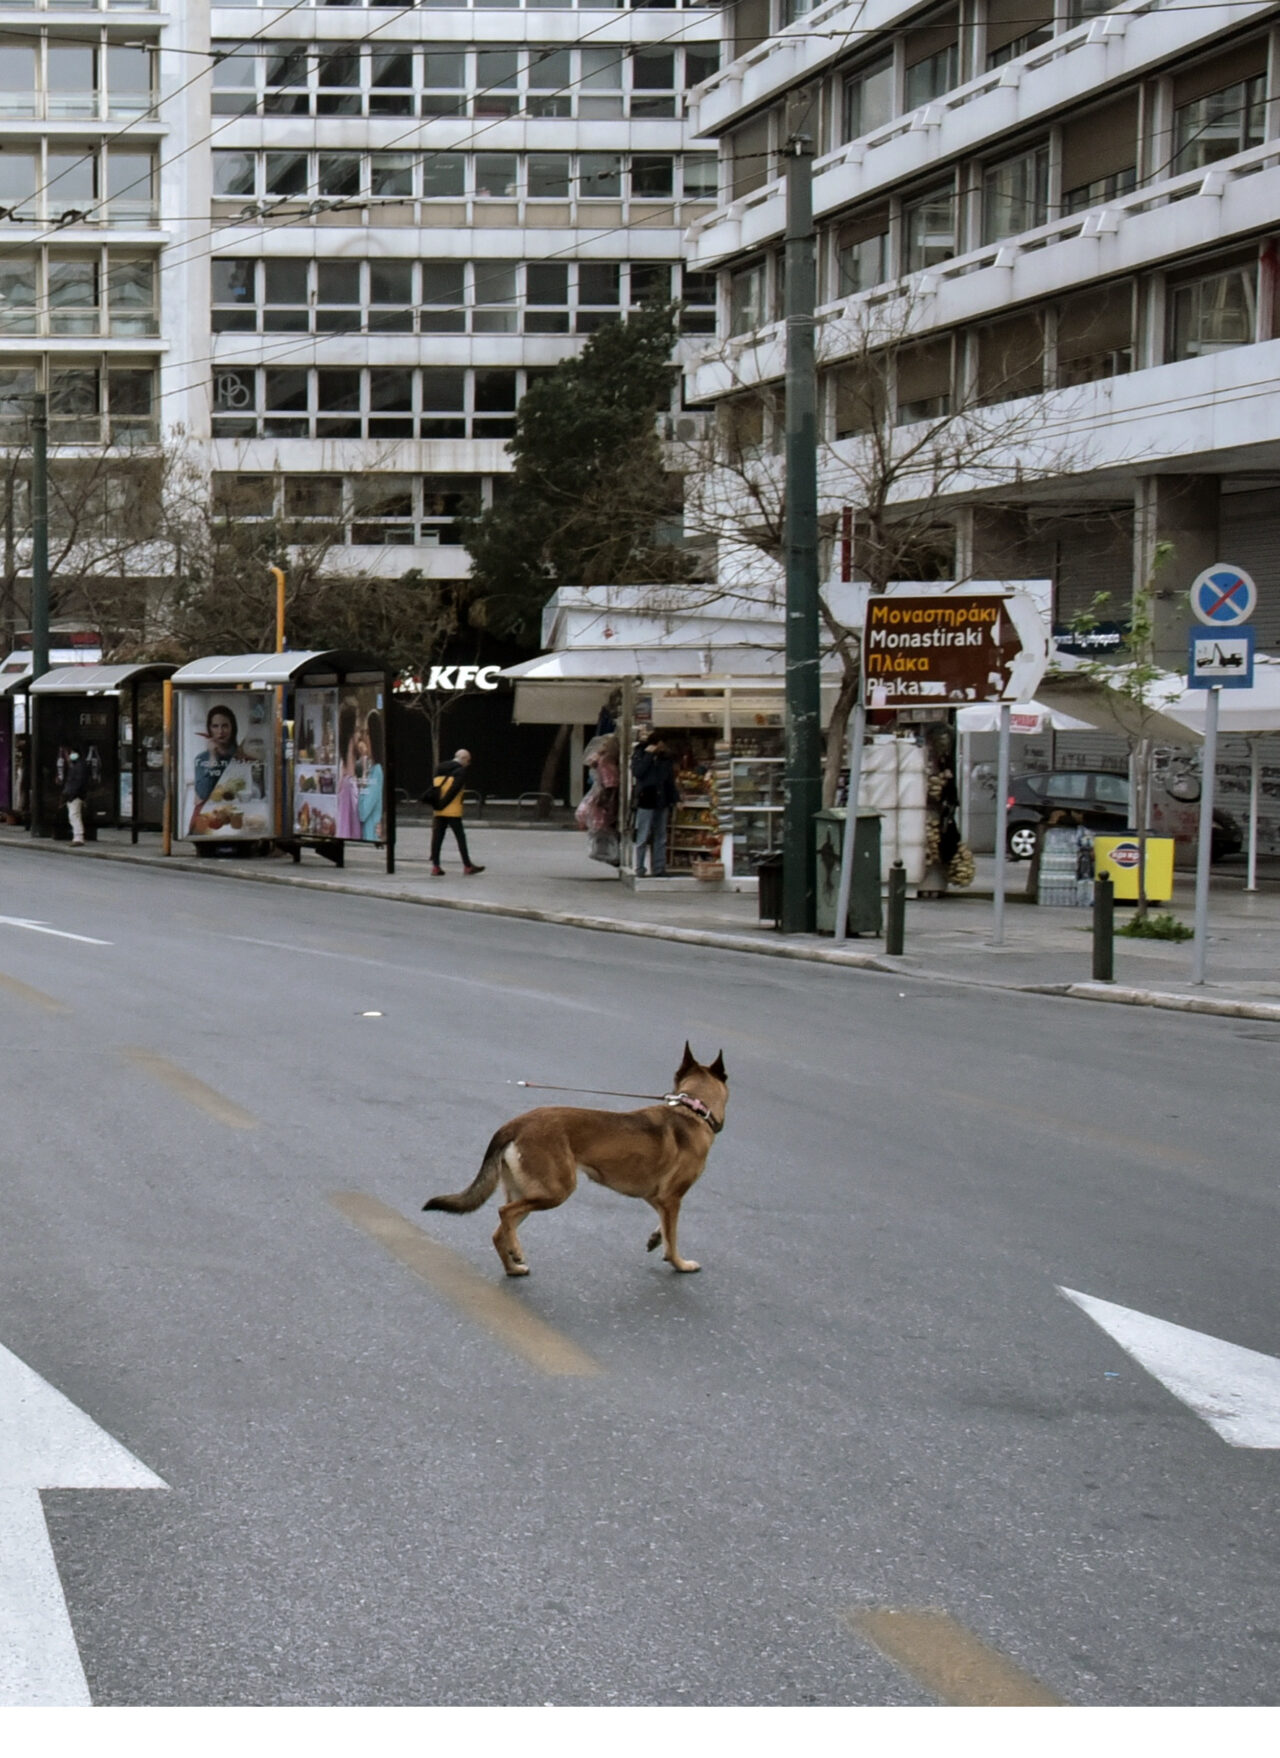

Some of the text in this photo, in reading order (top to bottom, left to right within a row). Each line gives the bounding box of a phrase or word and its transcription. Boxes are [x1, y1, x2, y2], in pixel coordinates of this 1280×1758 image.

[872, 603, 997, 627] Μοναστηράκι
[870, 627, 984, 649] Monastiraki
[868, 652, 930, 673] Πλάκα
[425, 665, 501, 690] KFC
